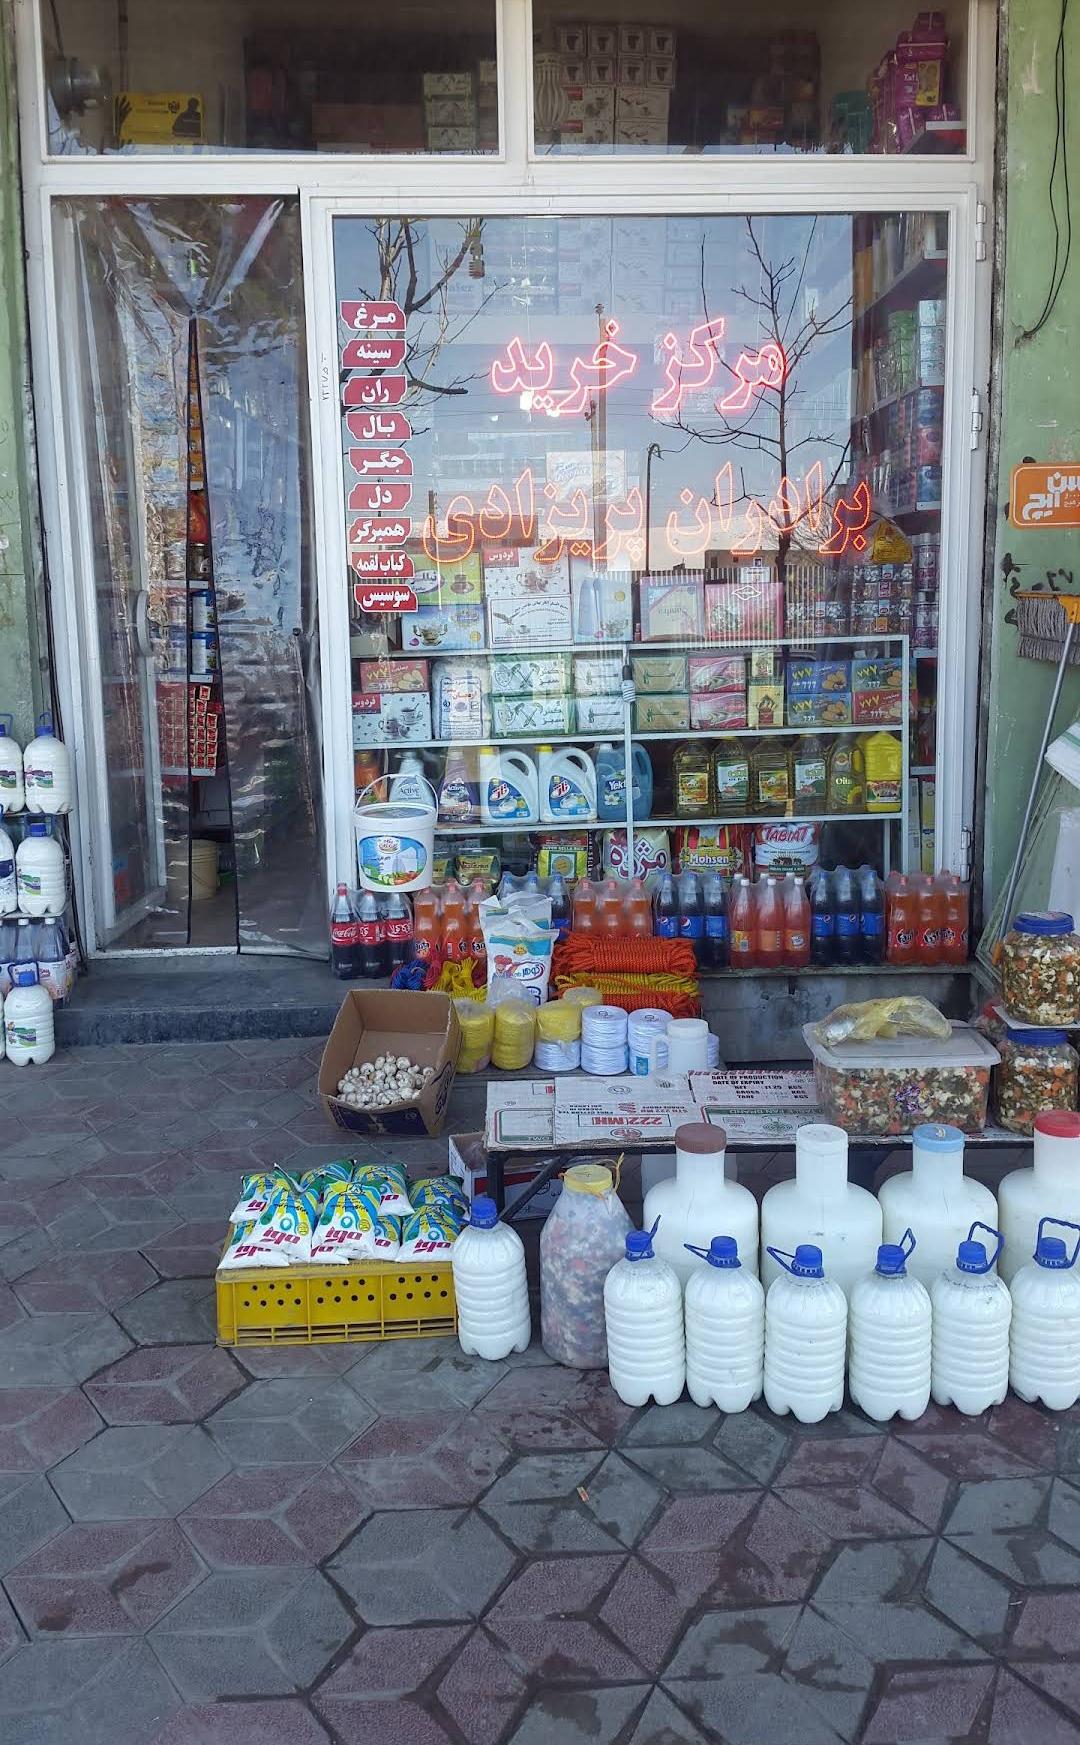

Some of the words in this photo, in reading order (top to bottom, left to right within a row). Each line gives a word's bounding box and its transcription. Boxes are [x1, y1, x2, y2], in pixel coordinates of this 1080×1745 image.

[353, 303, 397, 328] مرغ
[356, 343, 392, 364] سینه
[651, 317, 785, 412] مرکز
[491, 318, 637, 414] خرید
[361, 379, 390, 403] ران
[362, 414, 396, 438] بال
[359, 451, 404, 474] جگر
[368, 485, 393, 509] دل
[664, 460, 871, 555] برادران
[422, 466, 646, 563] پریزادی
[352, 520, 405, 543] همبرگر
[356, 554, 379, 571] لقمه
[379, 554, 406, 577] کباب
[362, 590, 410, 608] سوسیس
[689, 855, 719, 865] Mohsen
